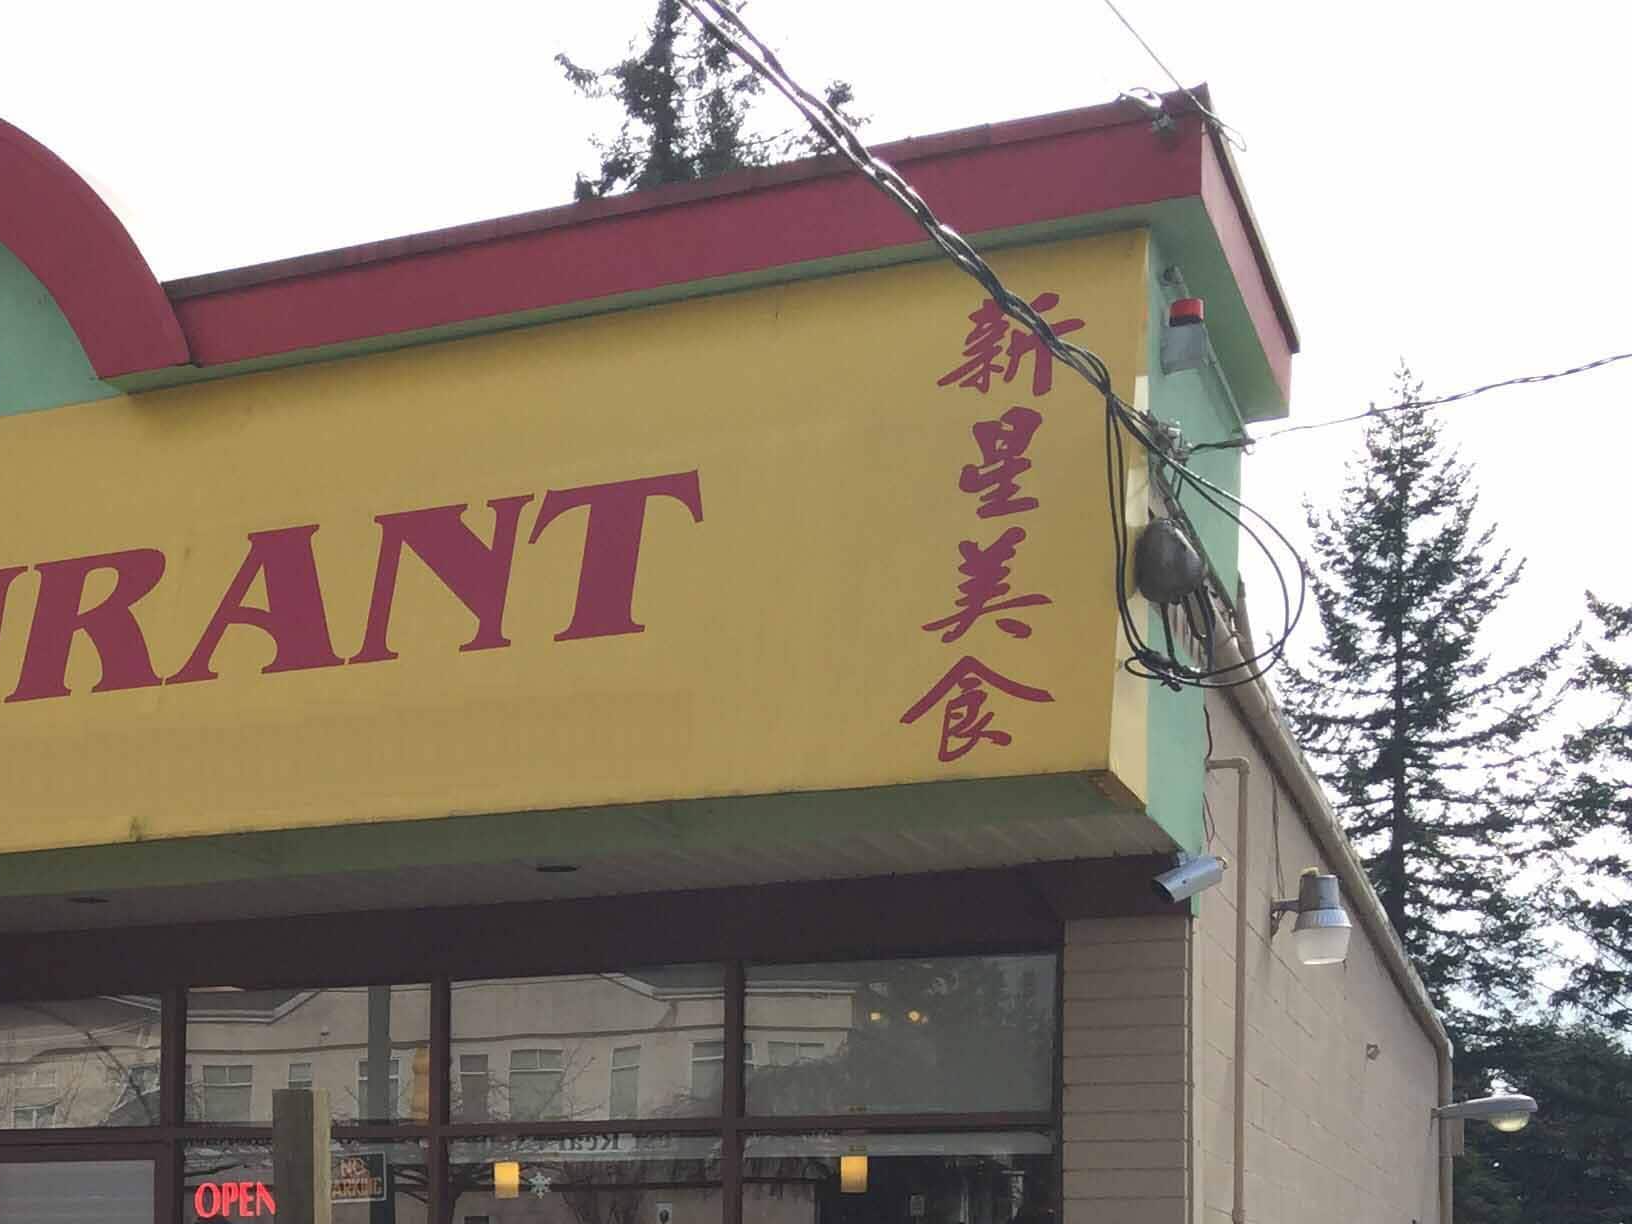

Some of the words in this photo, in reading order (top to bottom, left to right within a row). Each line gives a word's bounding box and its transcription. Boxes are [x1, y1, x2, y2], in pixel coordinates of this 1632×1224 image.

[899, 292, 1085, 762] 新星美食
[194, 1182, 276, 1218] OPEN
